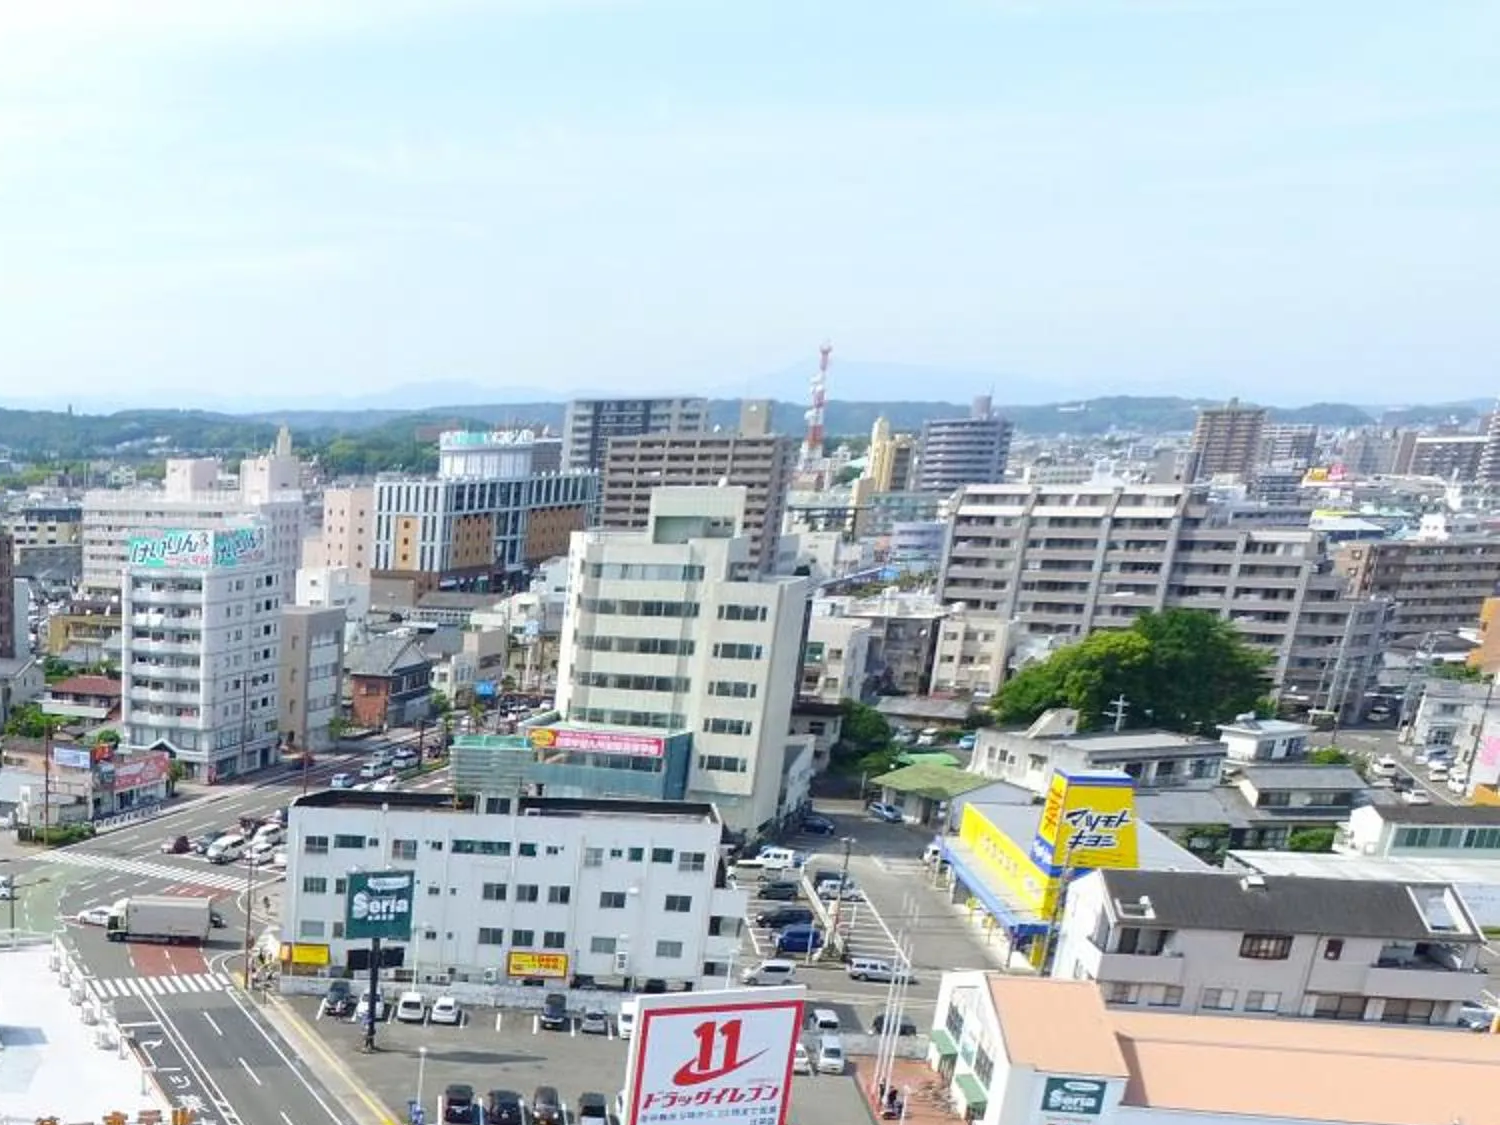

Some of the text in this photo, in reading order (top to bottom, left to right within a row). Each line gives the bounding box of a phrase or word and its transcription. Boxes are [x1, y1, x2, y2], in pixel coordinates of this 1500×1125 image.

[1065, 808, 1130, 832] マツモト
[1066, 829, 1115, 849] キヨシ
[352, 890, 409, 920] Seria
